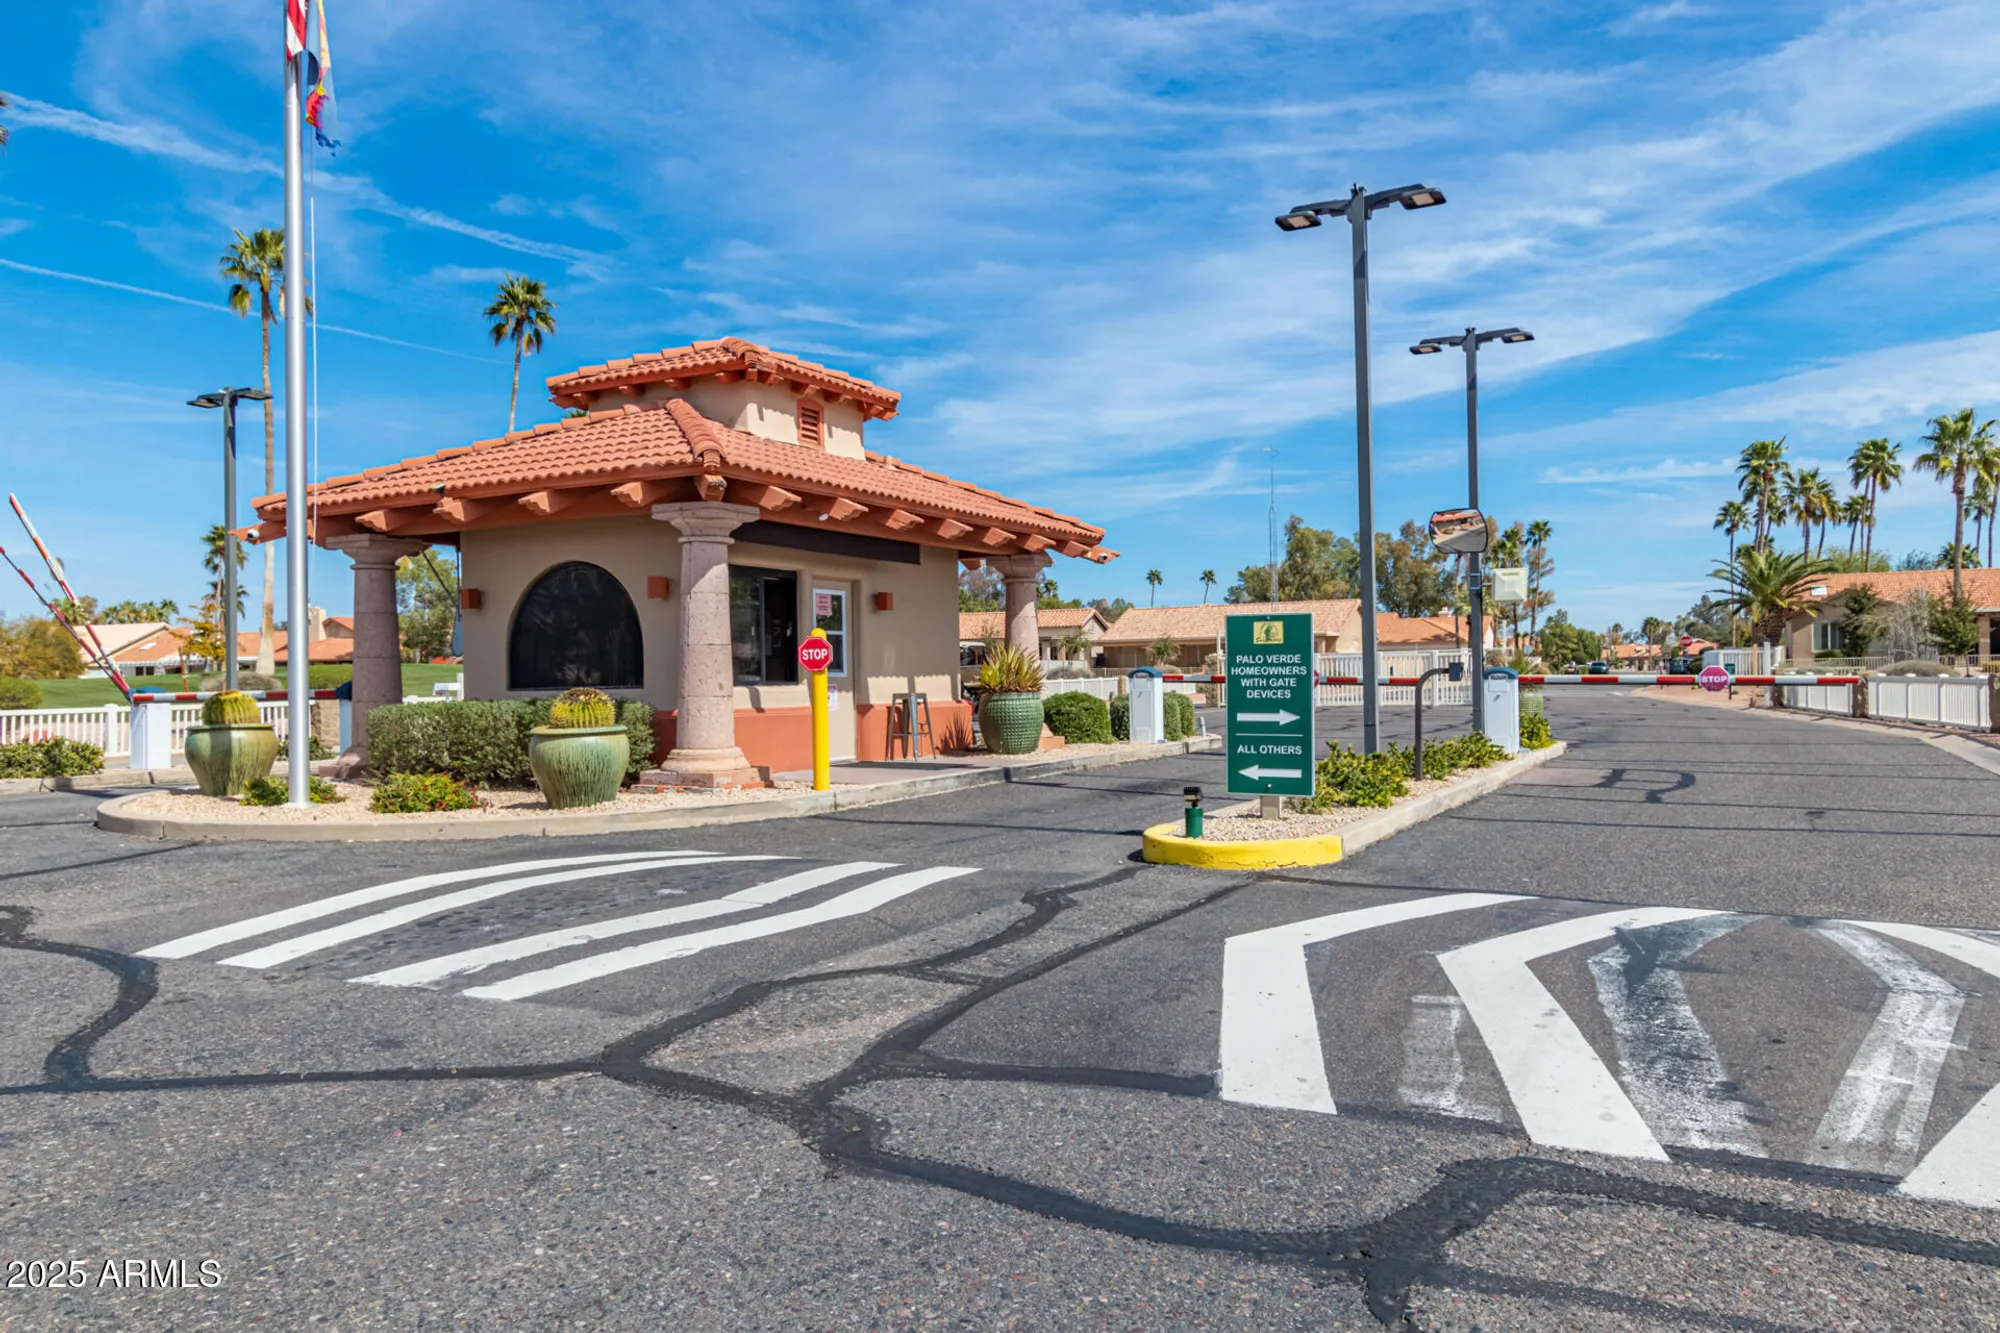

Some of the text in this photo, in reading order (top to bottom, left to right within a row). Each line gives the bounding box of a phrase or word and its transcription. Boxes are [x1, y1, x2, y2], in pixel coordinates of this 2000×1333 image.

[802, 648, 828, 660] STOP
[1236, 654, 1301, 664] PALO VERDE
[1231, 666, 1307, 676] HOMEOWNERS
[1240, 678, 1297, 688] WITH GATE
[1702, 675, 1727, 683] STOP
[1246, 690, 1291, 699] DEVICES
[1237, 744, 1302, 755] ALL OTHERS
